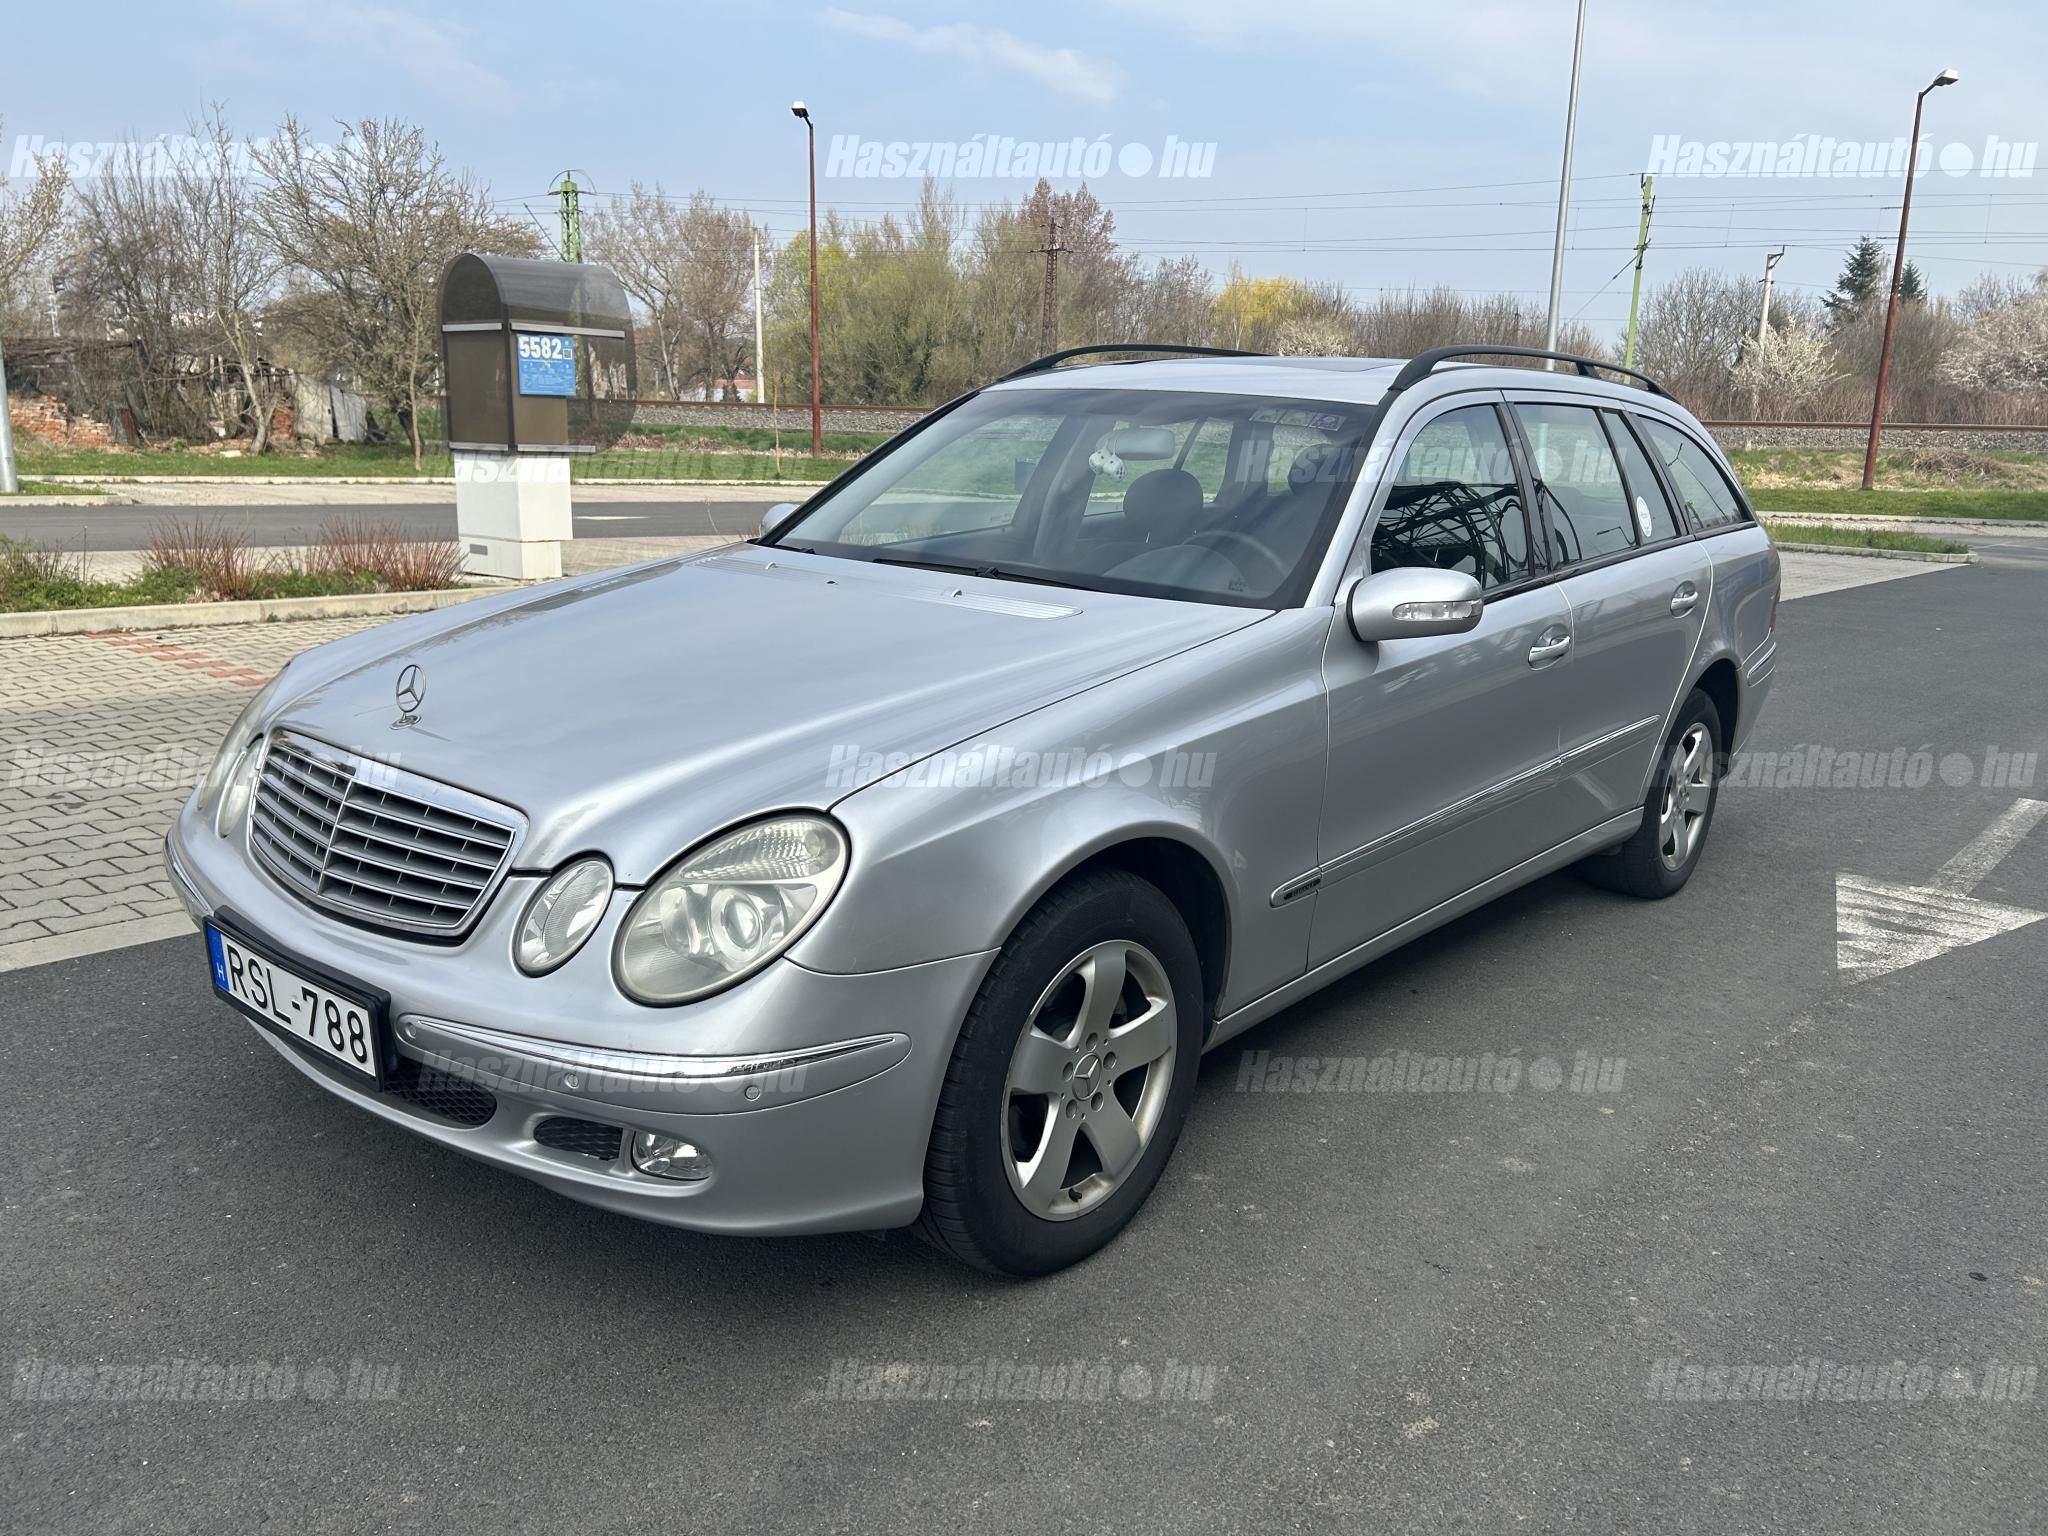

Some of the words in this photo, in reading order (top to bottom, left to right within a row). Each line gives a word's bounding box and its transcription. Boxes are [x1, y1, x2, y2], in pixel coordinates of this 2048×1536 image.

[518, 336, 563, 360] 5582
[216, 963, 225, 981] H
[227, 943, 368, 1064] RSL-788
